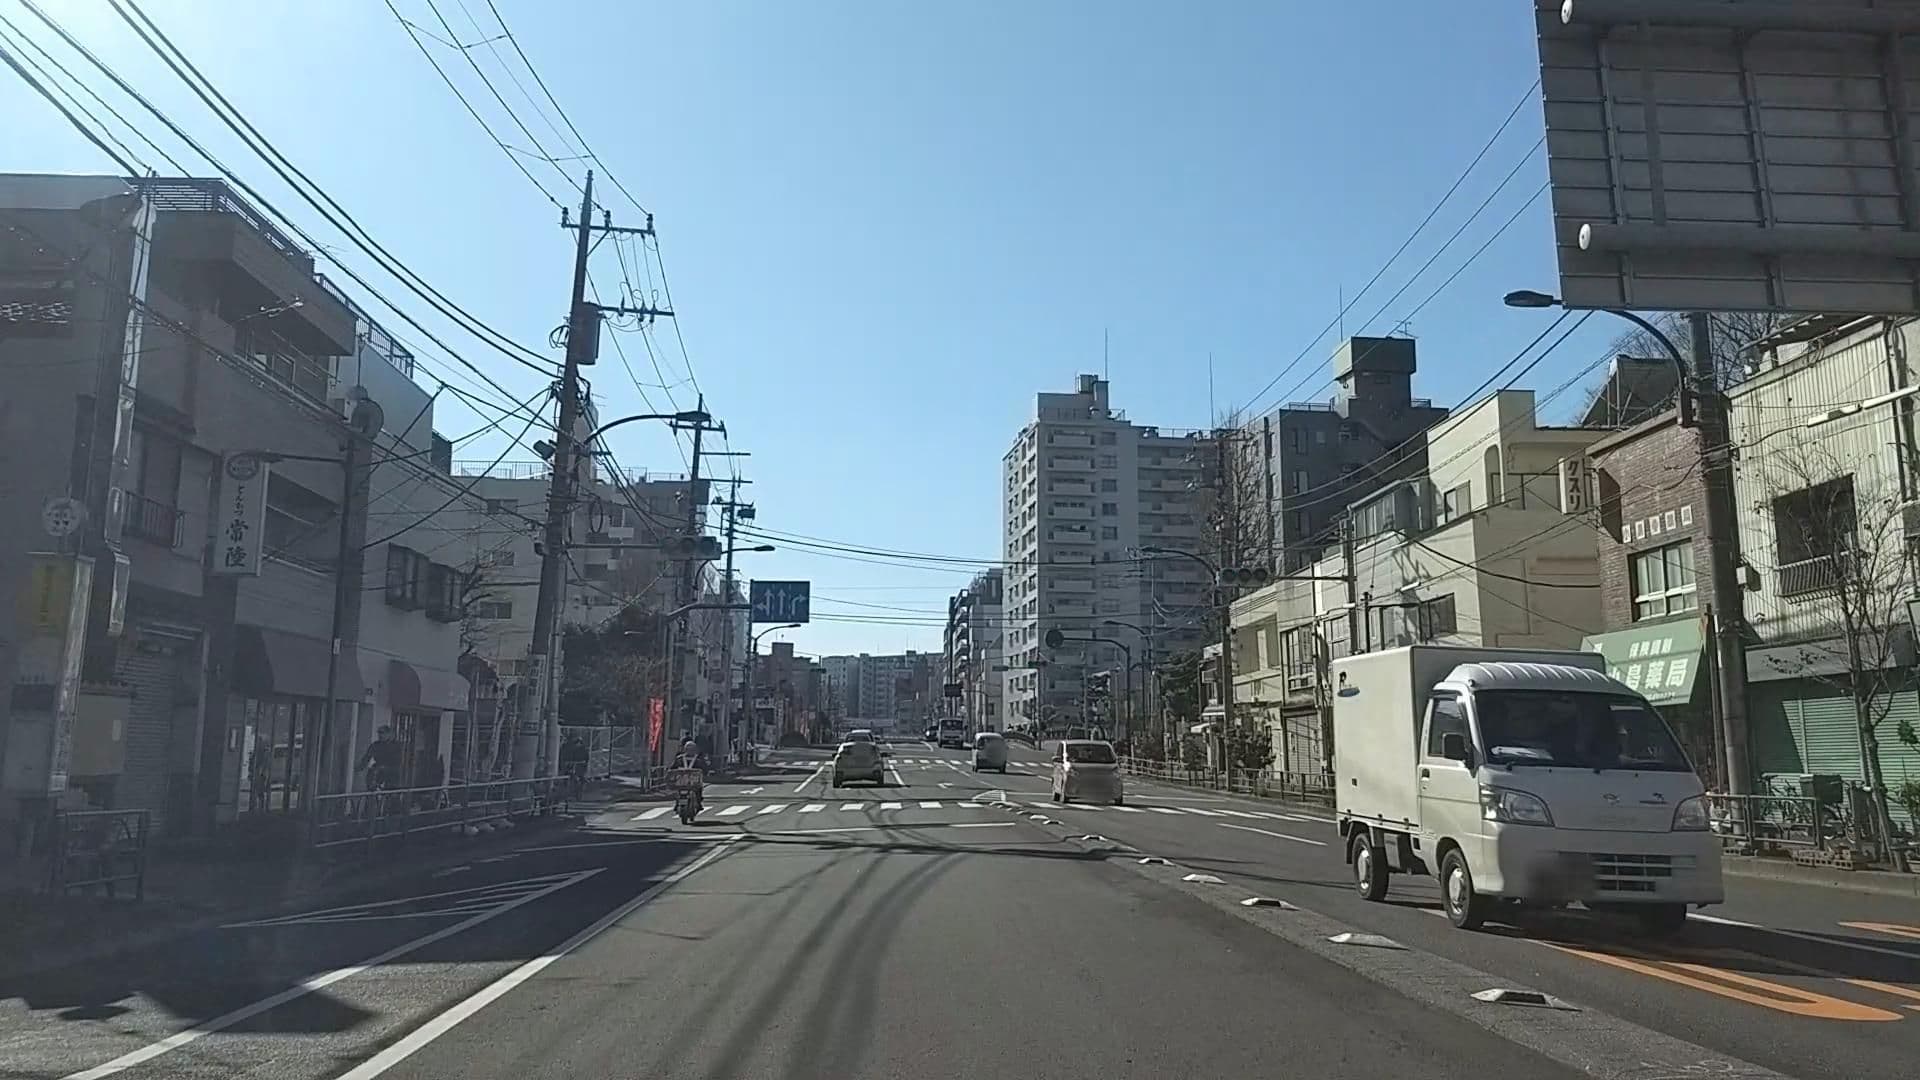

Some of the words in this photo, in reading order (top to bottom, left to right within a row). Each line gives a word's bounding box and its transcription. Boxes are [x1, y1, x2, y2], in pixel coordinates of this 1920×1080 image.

[1568, 460, 1581, 511] クスリ
[225, 519, 249, 568] 常陸
